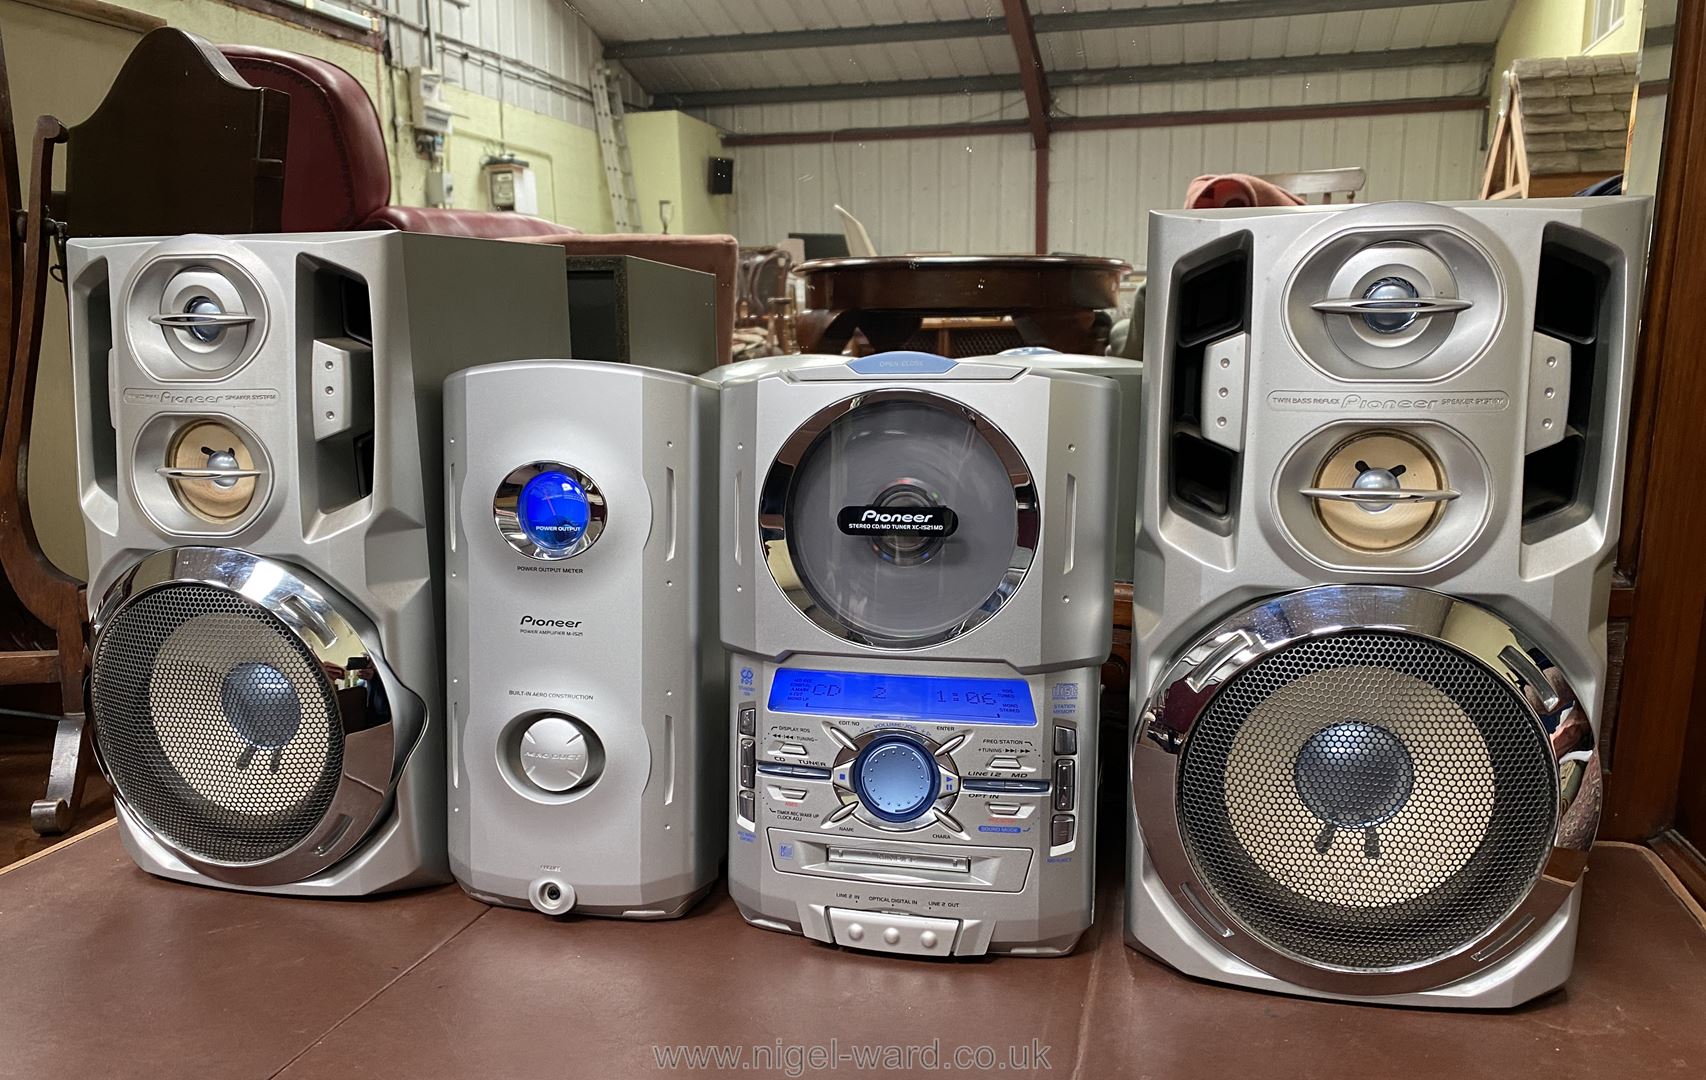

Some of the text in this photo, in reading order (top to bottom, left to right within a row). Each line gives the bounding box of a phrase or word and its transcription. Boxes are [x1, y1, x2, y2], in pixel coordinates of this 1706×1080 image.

[160, 391, 224, 403] Pioneer
[1292, 397, 1312, 405] BASS
[1341, 393, 1440, 409] Pioneer
[861, 510, 933, 523] Pioneer
[520, 615, 582, 628] Pioneer
[548, 692, 594, 701] CONSTRUCTION
[812, 683, 841, 697] CD
[872, 687, 887, 699] 2
[779, 725, 799, 733] DISPLAY
[798, 759, 826, 767] TUNER
